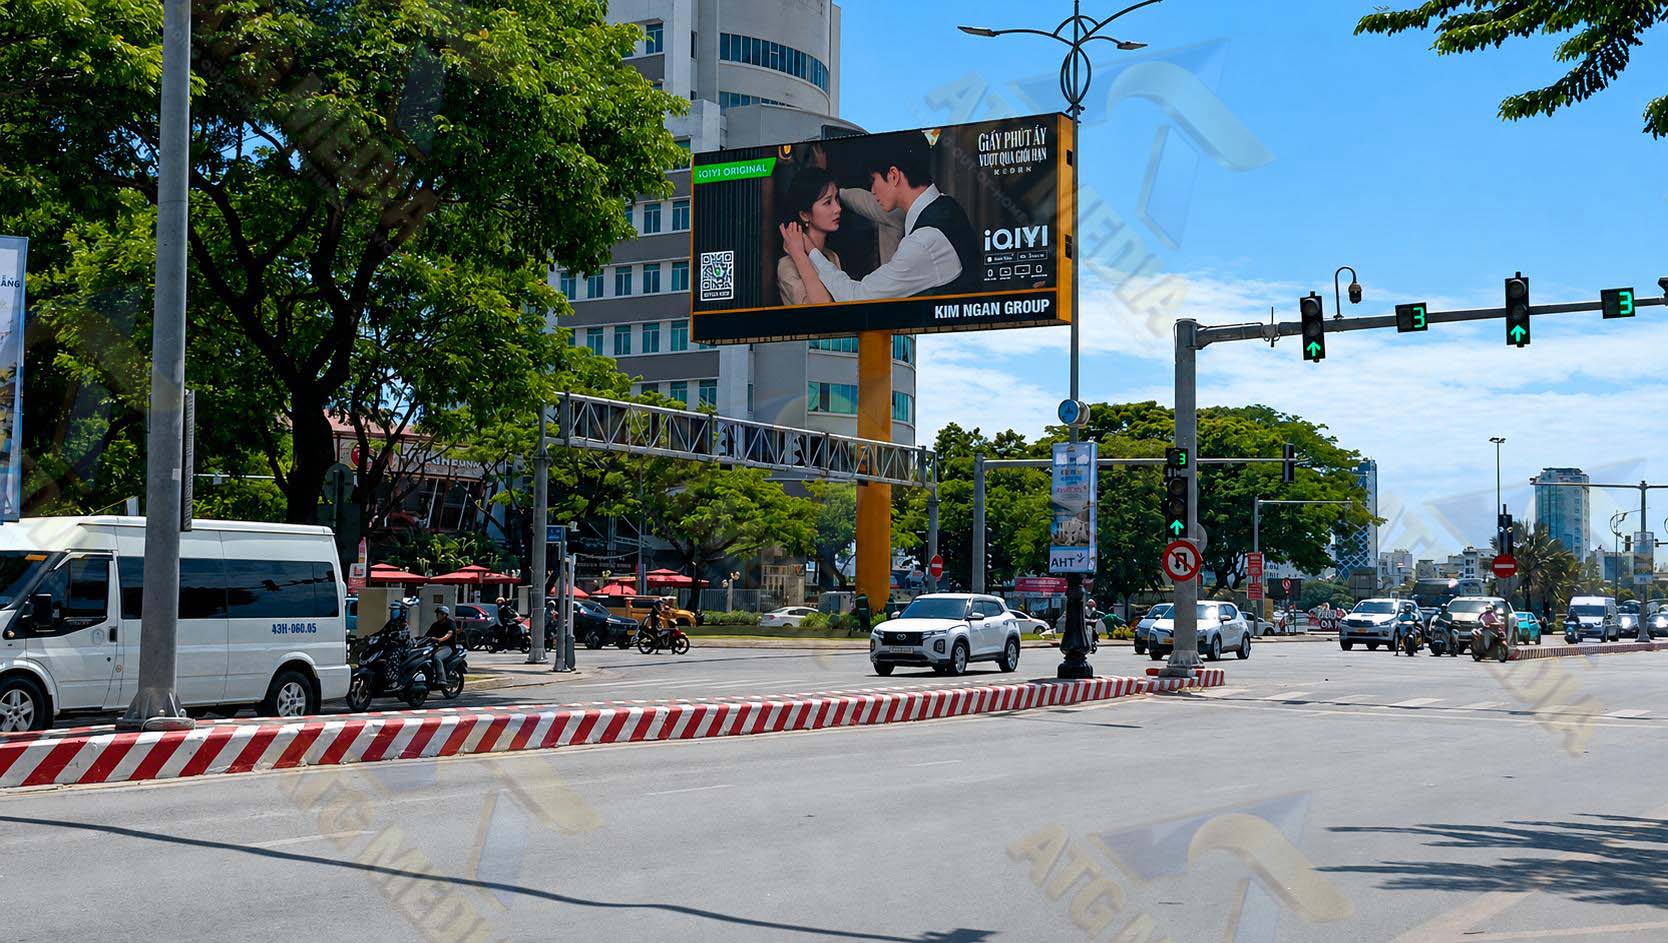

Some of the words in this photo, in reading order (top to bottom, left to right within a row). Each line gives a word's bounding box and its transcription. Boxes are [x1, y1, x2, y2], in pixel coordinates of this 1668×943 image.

[723, 164, 767, 176] ORIGINAL
[984, 225, 1048, 251] iQIYI
[934, 304, 959, 319] KIM
[963, 302, 1000, 317] NGAN
[1004, 299, 1050, 315] GROUP
[1619, 291, 1632, 315] 3
[1412, 306, 1425, 328] 3
[1179, 452, 1187, 465] 3
[1051, 557, 1075, 567] AHT
